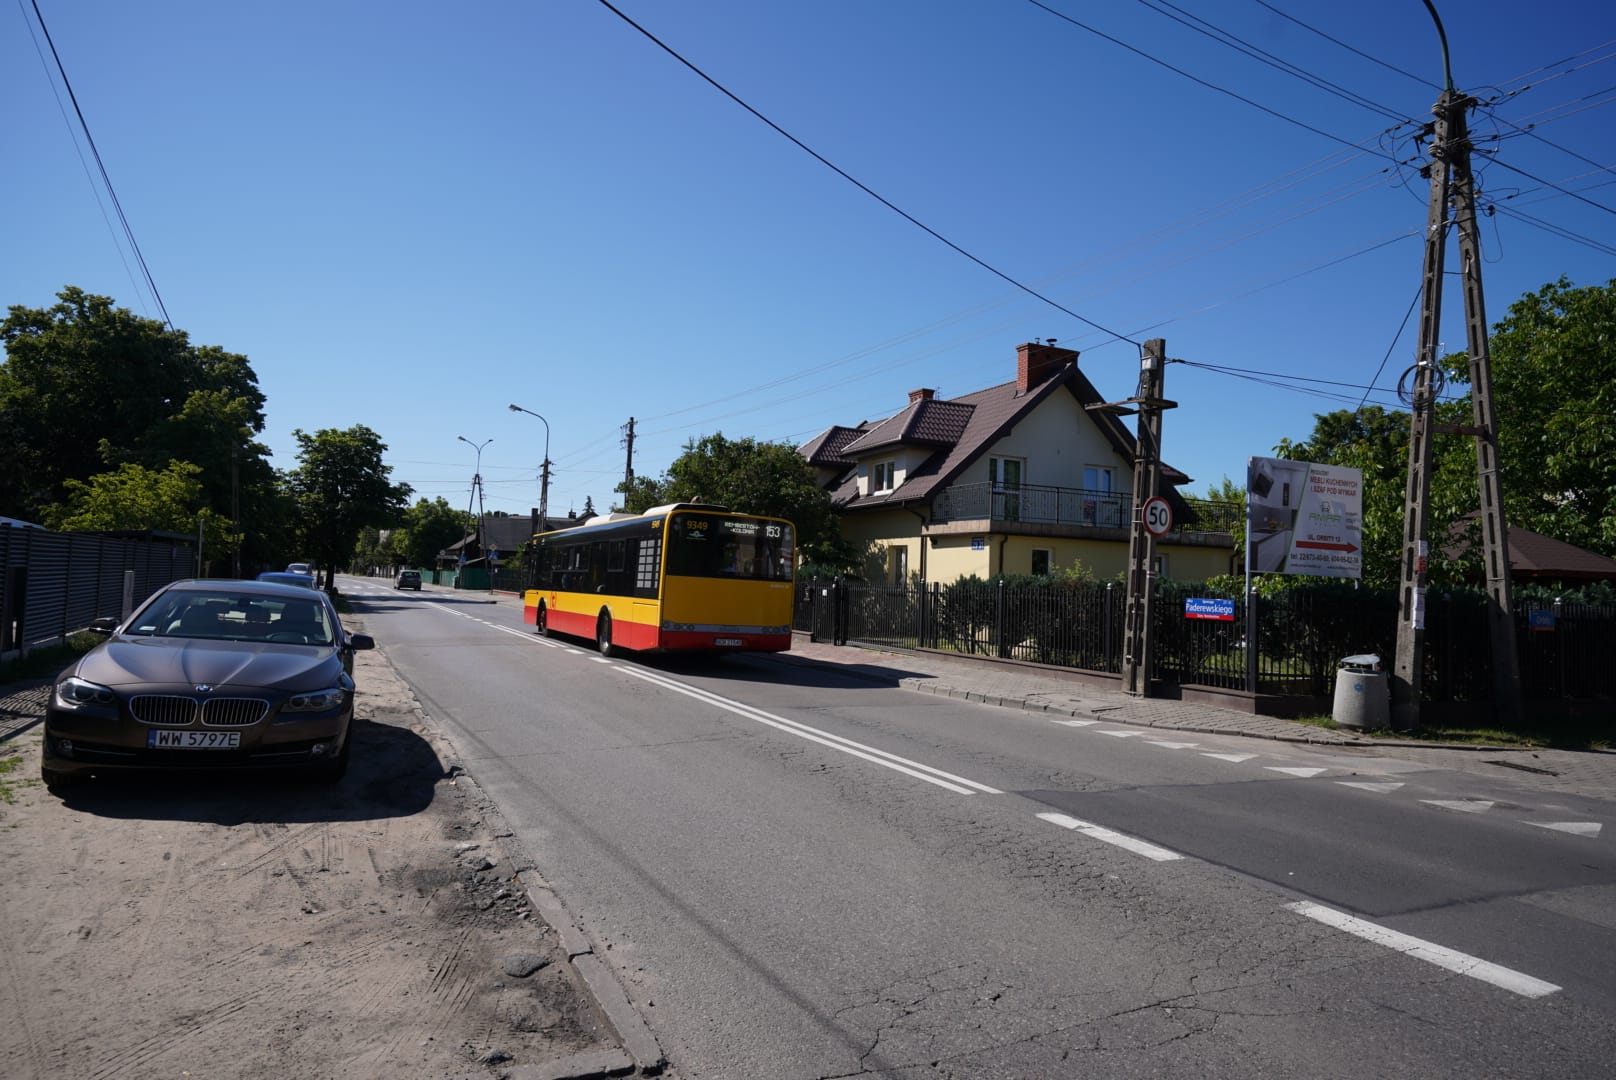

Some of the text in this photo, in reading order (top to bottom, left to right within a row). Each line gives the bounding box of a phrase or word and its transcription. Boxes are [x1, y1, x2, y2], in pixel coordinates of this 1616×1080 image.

[1149, 506, 1168, 527] 50
[687, 520, 708, 530] 9349
[766, 525, 781, 538] 153
[1185, 602, 1233, 616] Paderewskiego
[159, 732, 239, 746] WW 5797E
